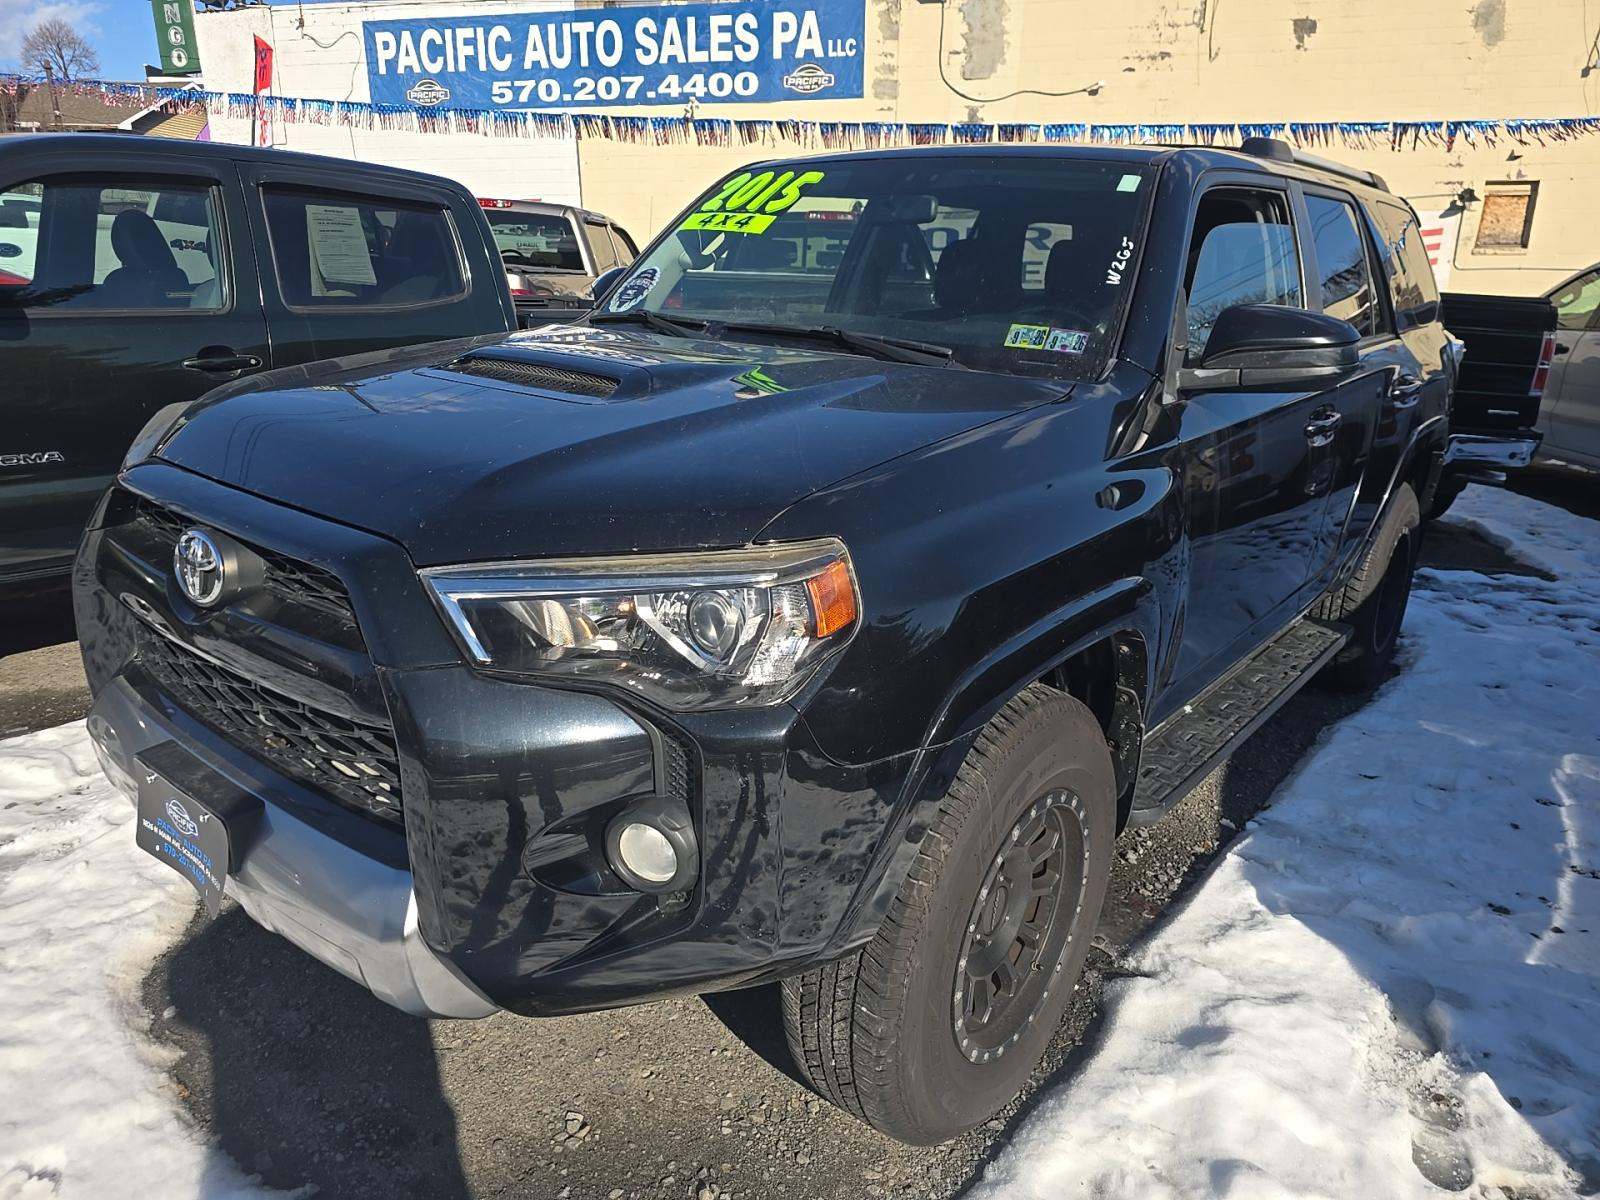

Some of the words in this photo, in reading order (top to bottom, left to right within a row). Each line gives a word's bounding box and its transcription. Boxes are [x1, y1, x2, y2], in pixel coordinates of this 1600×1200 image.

[375, 25, 513, 75] PACIFIC
[523, 19, 624, 70] AUTO
[634, 12, 760, 66] SALES
[772, 10, 825, 60] PA
[827, 37, 857, 58] LLC
[410, 91, 446, 99] PACIFIC
[491, 71, 760, 104] 570.207.4400
[787, 76, 830, 86] PACIFIC
[701, 171, 825, 214] 2015
[168, 807, 194, 832] PACIFIC
